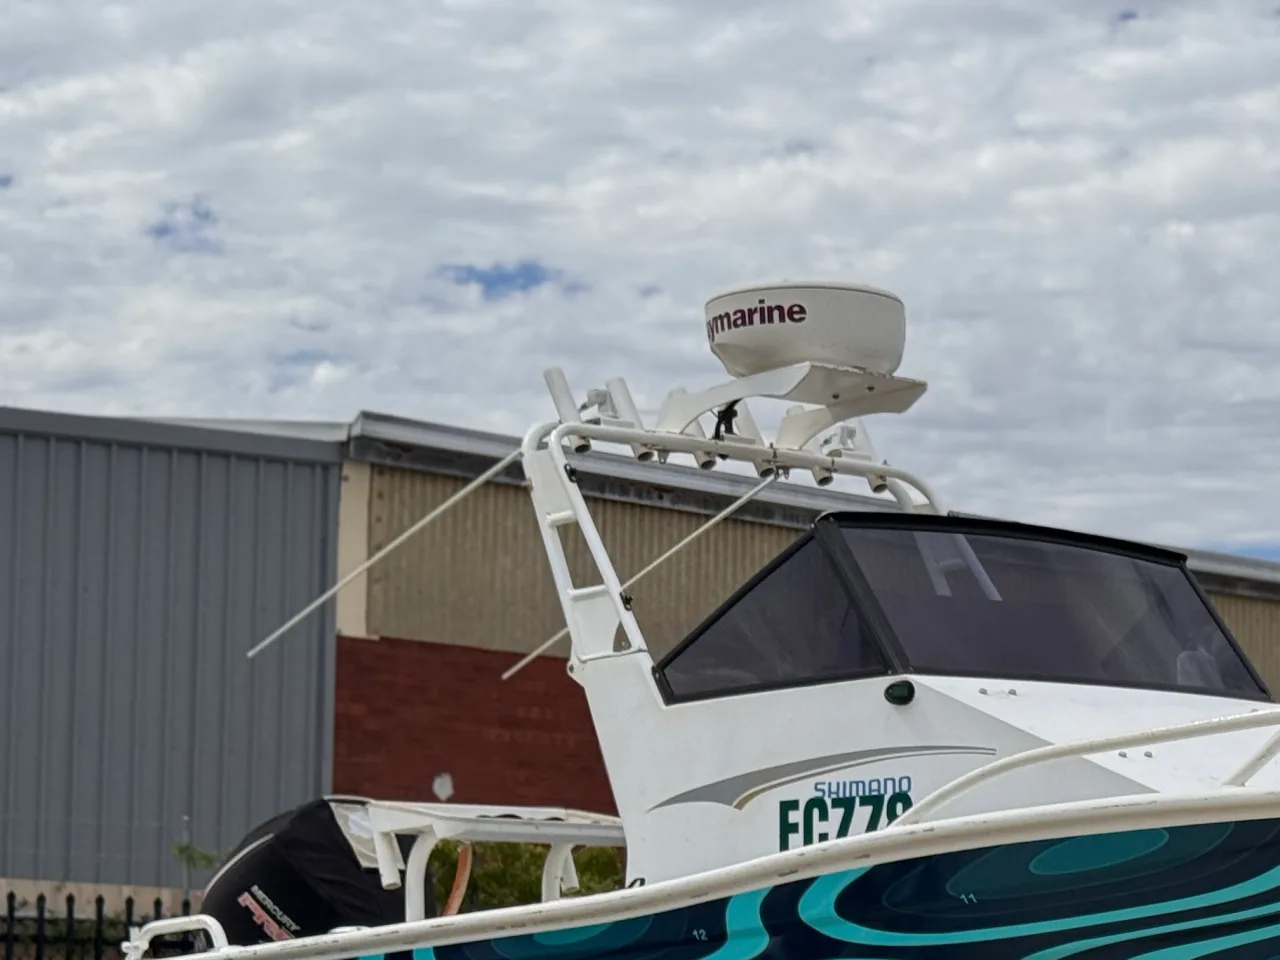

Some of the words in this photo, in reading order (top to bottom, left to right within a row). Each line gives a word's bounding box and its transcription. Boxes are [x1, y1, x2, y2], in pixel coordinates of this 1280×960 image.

[814, 776, 912, 799] SHIMANO
[960, 893, 977, 904] 11
[251, 885, 301, 931] MERCURY
[692, 929, 708, 940] 12
